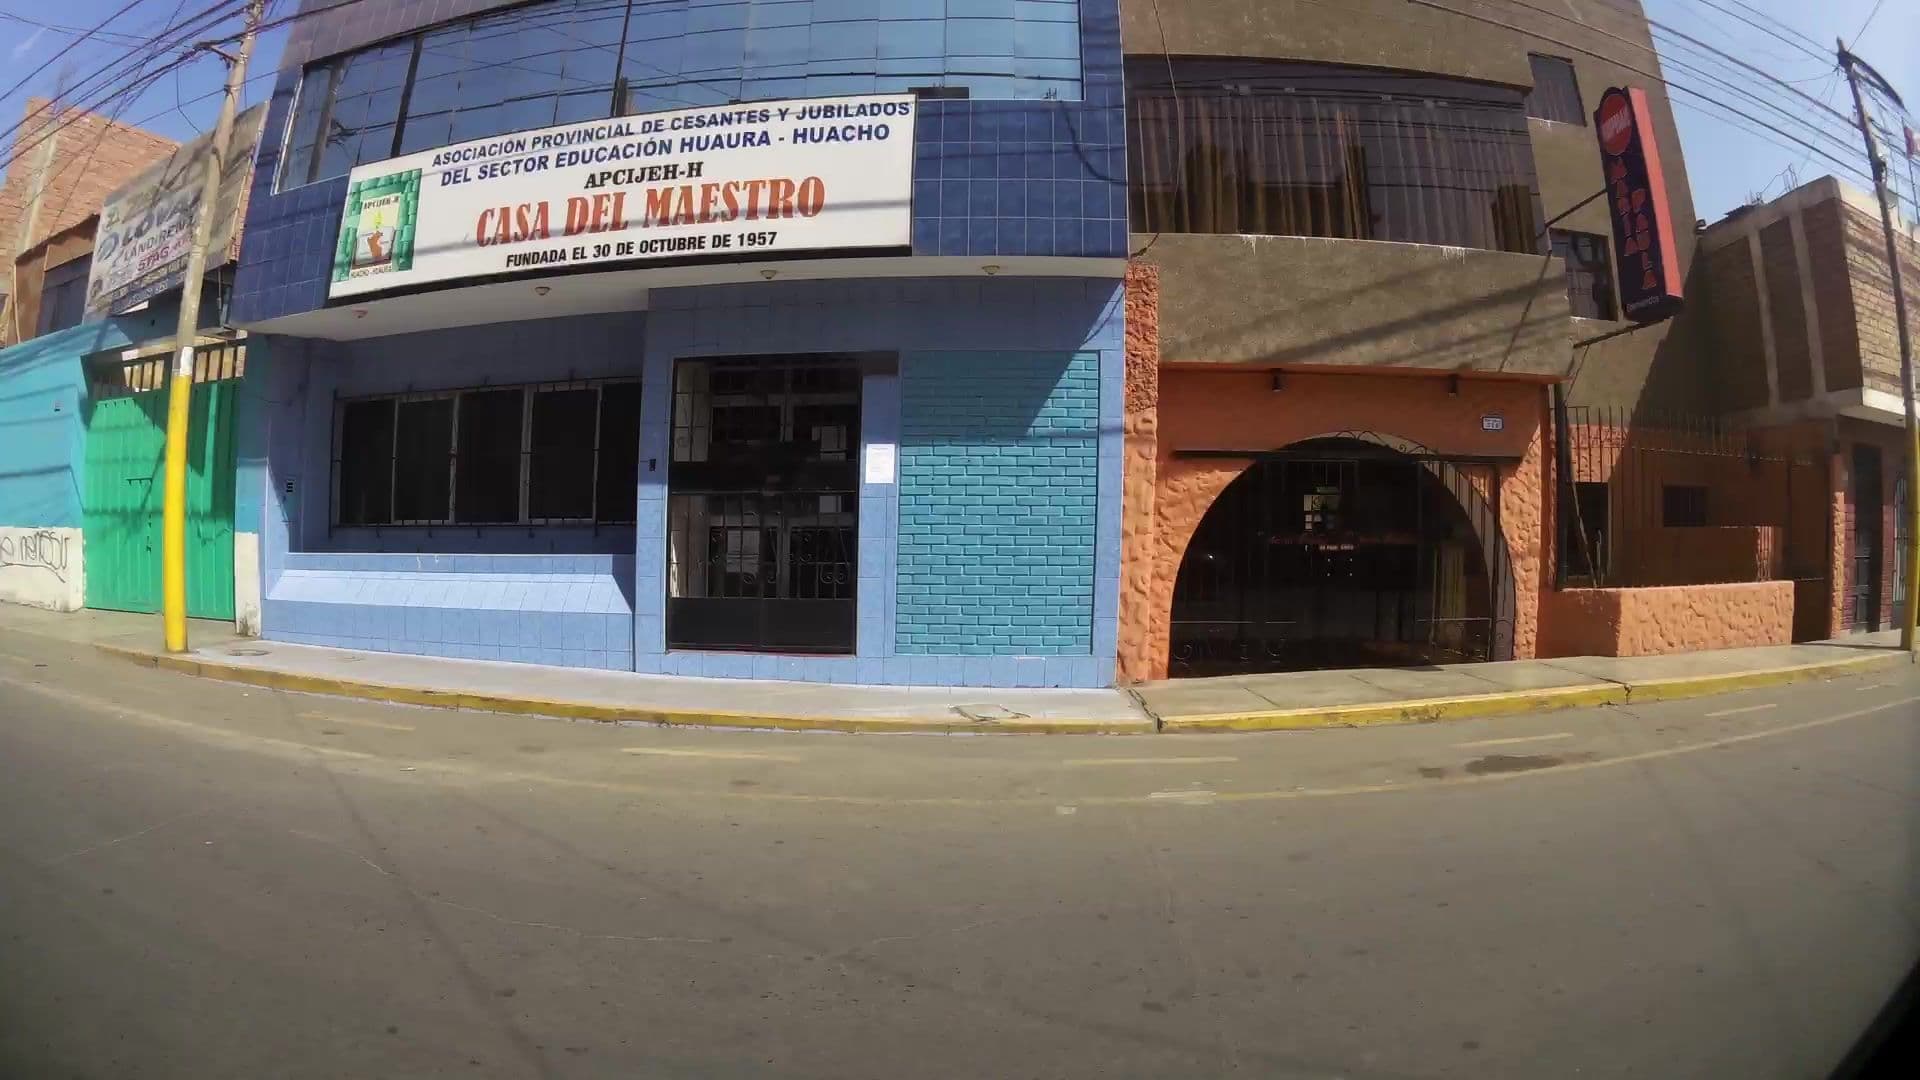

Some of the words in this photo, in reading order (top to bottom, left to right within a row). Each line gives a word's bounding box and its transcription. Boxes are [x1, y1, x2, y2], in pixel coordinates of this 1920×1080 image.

[432, 138, 526, 167] ASOCIACIÓN
[531, 122, 634, 150] PROVINCIAL
[641, 118, 664, 134] DE
[671, 108, 770, 130] CESANTES
[778, 108, 789, 121] Y
[796, 102, 910, 120] JUBILADOS
[441, 168, 472, 187] DEL
[478, 155, 549, 180] SECTOR
[555, 137, 673, 168] EDUCACIÓN
[680, 130, 771, 153] HUAURA
[793, 124, 890, 144] HUACHO
[584, 161, 704, 189] APCIJEH-H
[476, 201, 549, 247] CASA
[564, 191, 629, 236] DEL
[642, 176, 825, 228] MAESTRO
[506, 249, 567, 267] FUNDADA
[572, 246, 587, 260] EL
[593, 243, 610, 258] 30
[616, 241, 634, 256] DE
[640, 235, 706, 254] OCTUBRE
[712, 233, 731, 248] DE
[737, 231, 778, 246] 1957
